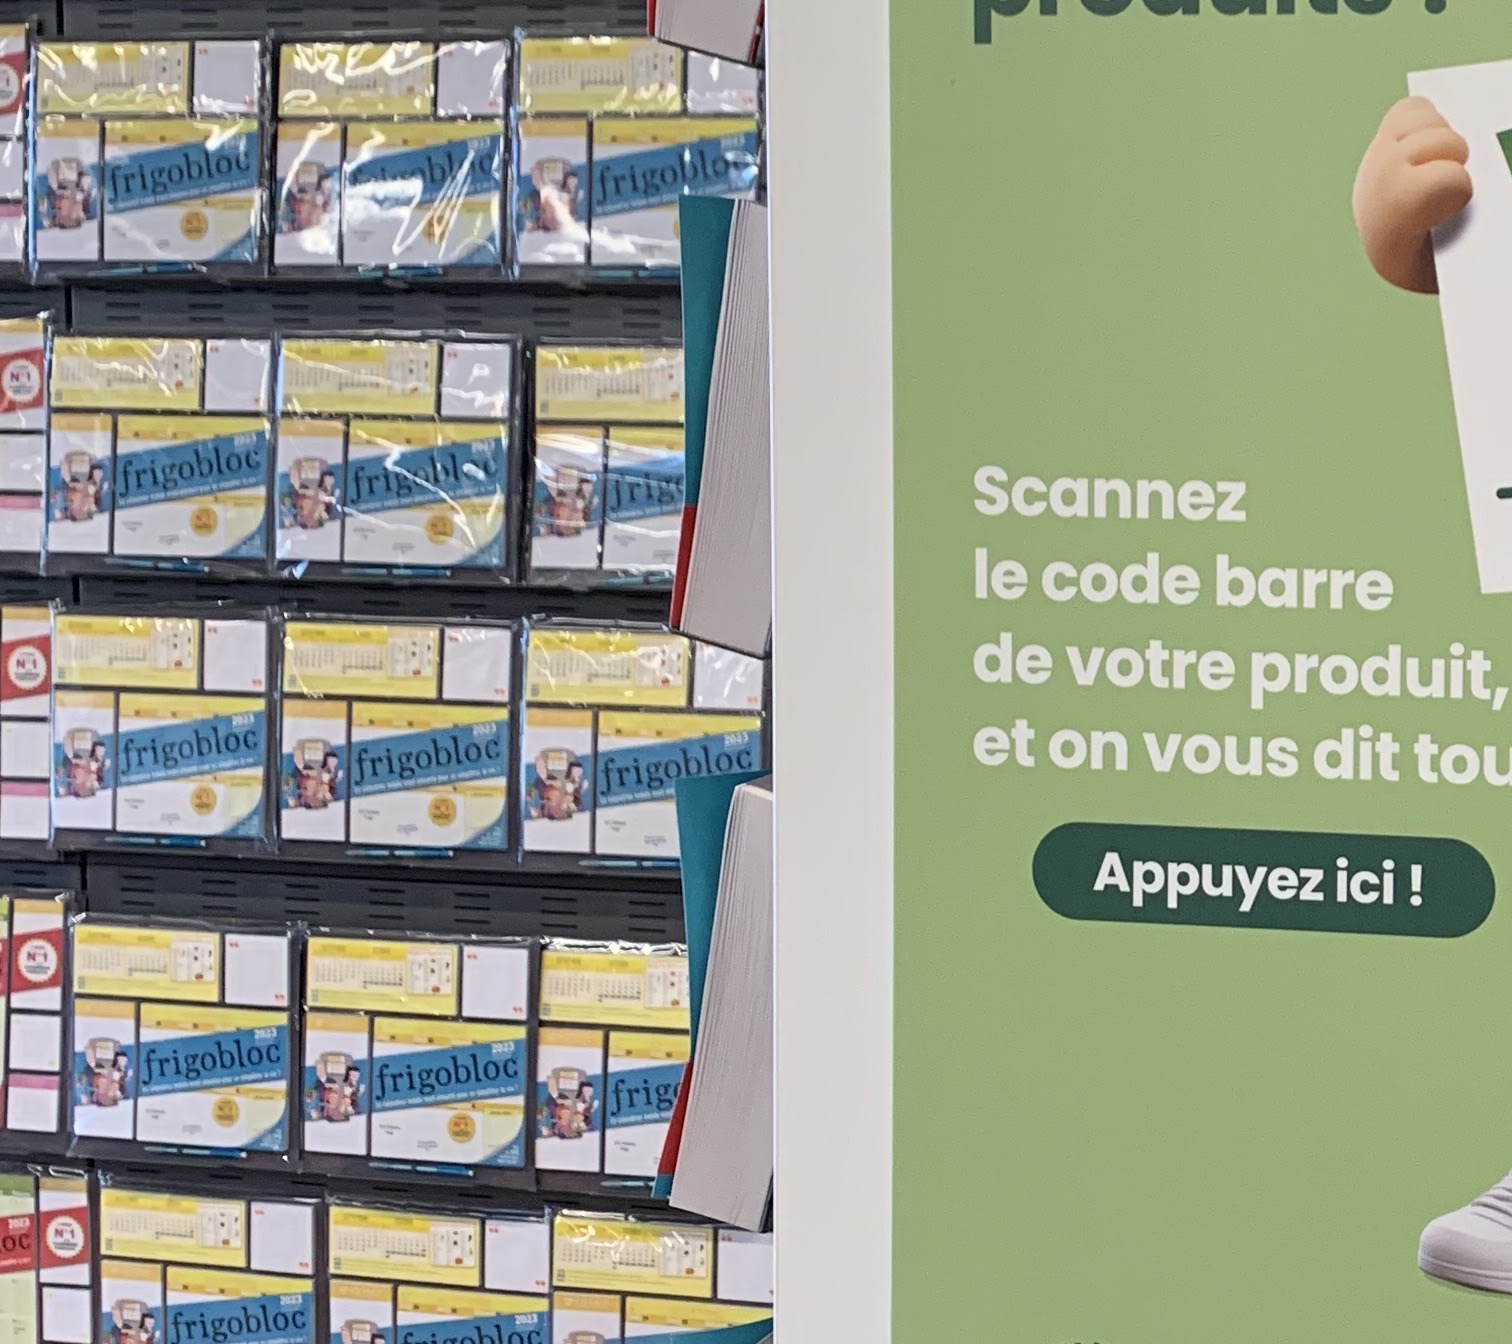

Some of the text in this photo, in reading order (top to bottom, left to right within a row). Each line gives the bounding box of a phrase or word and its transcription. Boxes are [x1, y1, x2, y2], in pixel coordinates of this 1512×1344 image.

[108, 149, 250, 201] frigobloc
[119, 444, 260, 497] frigobloc
[973, 465, 1247, 522] Scannez
[973, 547, 1394, 612] le code barre
[973, 632, 1509, 711] de votre produit,
[121, 724, 258, 775] frigobloc
[353, 734, 500, 784] frigobloc
[600, 745, 752, 795] frigobloc
[973, 719, 1035, 768] et
[1048, 729, 1128, 771] on
[1142, 732, 1299, 777] vous
[1313, 725, 1400, 782] dit
[1093, 851, 1423, 912] Appuyez ici !
[143, 1038, 281, 1084] frigobloc
[375, 1053, 519, 1100] frigobloc
[515, 1313, 539, 1325] 2023
